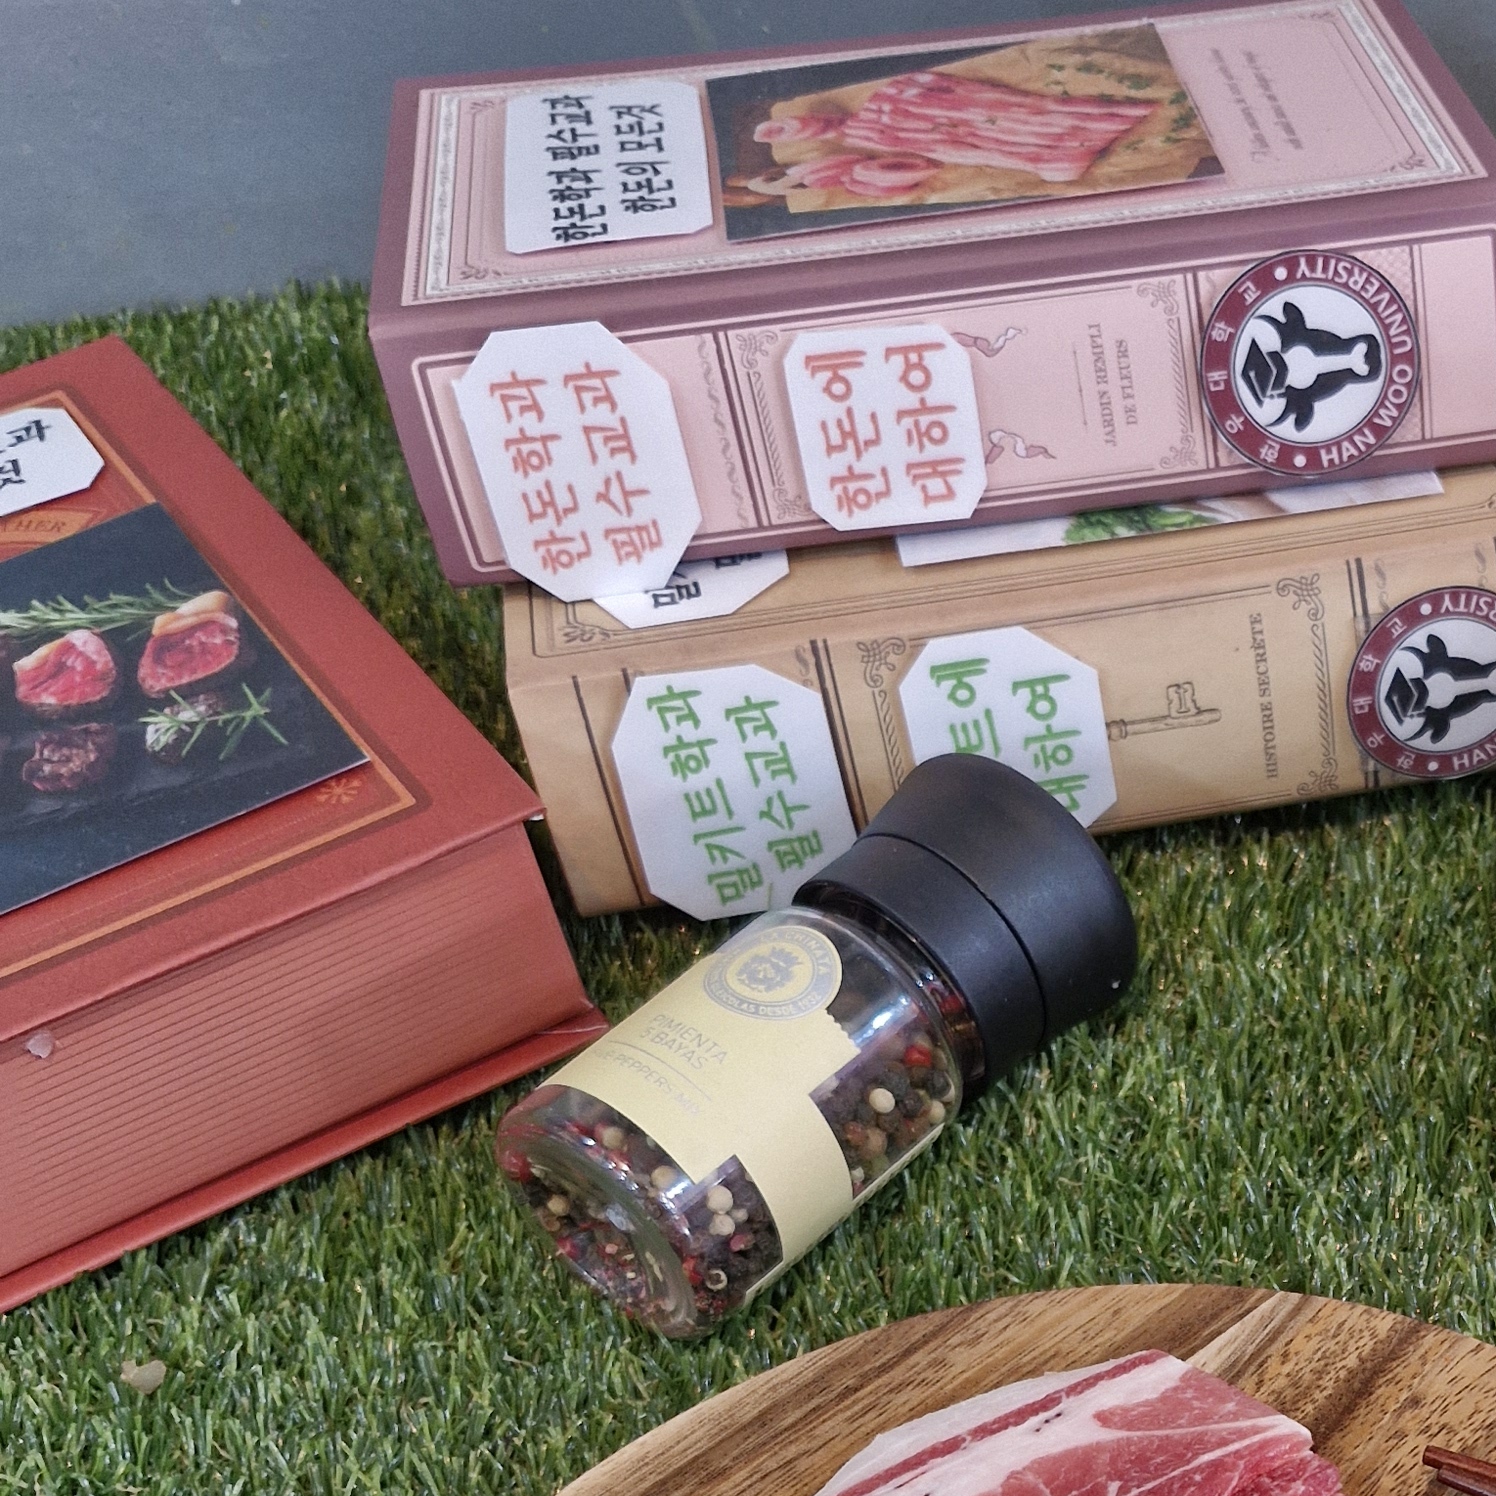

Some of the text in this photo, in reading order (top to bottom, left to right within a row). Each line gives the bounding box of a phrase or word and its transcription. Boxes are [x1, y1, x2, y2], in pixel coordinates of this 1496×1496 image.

[541, 94, 609, 243] 한돈학과 필수교과
[608, 103, 677, 214] 한돈의 모든것
[884, 341, 966, 509] 대하여
[1087, 323, 1118, 447] JARDIN REMPLI
[1115, 338, 1139, 426] DE FLEURS
[1296, 256, 1413, 468] HAN WOO UNIVERSITY
[488, 369, 593, 576] 한돈학과
[562, 361, 663, 566] 필수교과
[803, 349, 892, 518] 한돈에
[645, 684, 764, 907] 밀키트학과
[723, 694, 825, 873] 필수교과
[1259, 701, 1279, 781] HISTOIRE
[785, 930, 832, 975] CHINATA
[613, 1053, 673, 1093] PEPPERS
[650, 1031, 709, 1070] BAYAS
[652, 1013, 729, 1065] PIMIENTA
